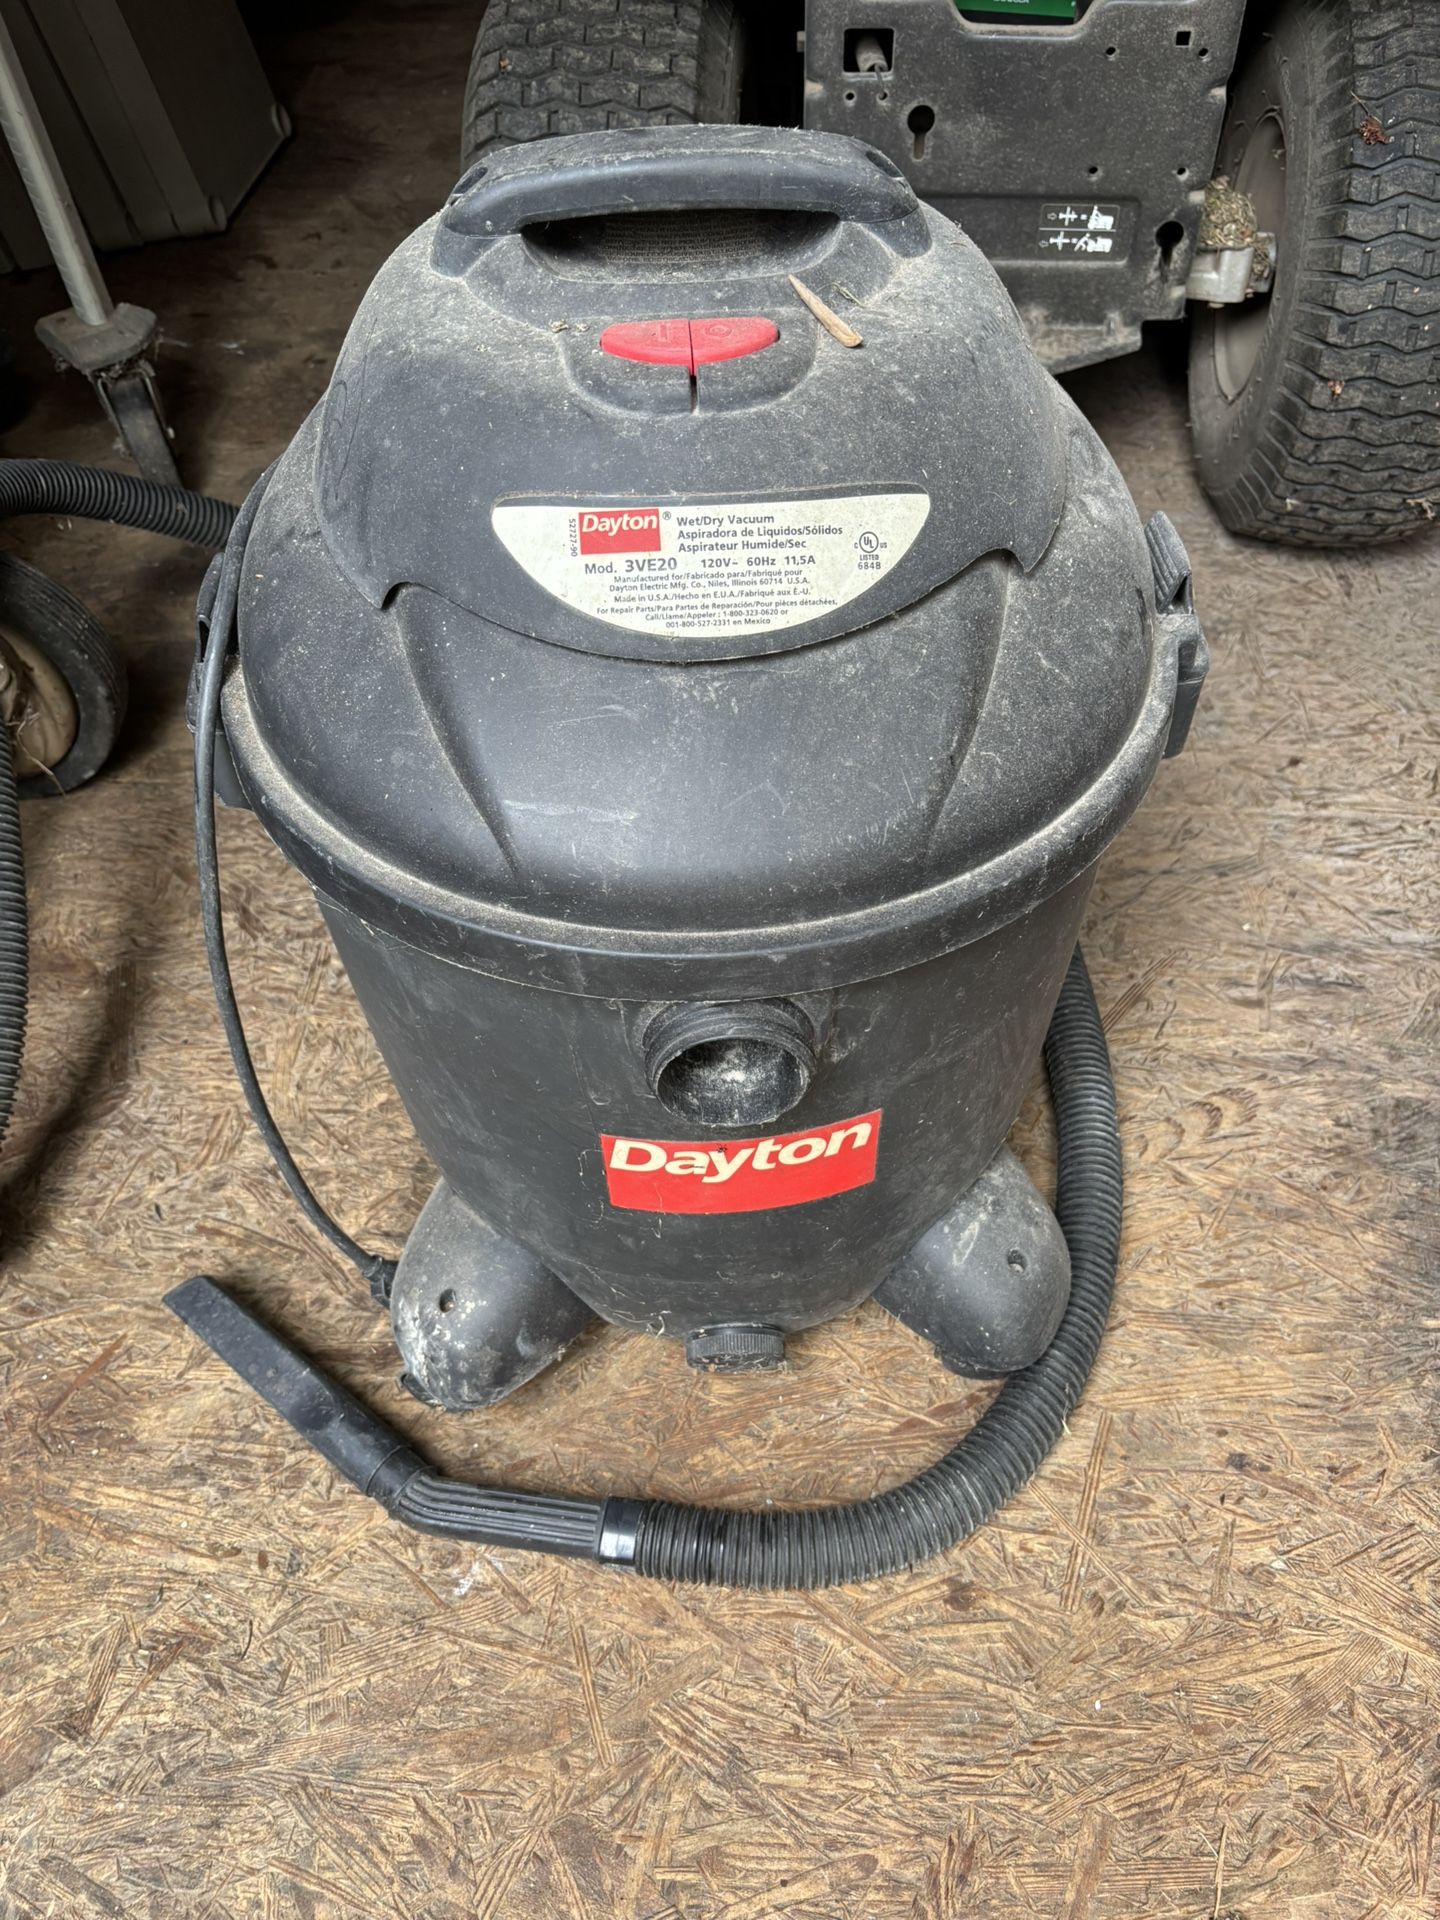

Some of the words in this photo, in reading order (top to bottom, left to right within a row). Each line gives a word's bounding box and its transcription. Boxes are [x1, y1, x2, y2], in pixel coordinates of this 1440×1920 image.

[582, 513, 657, 536] Dayton
[677, 516, 724, 527] Wet/Dry
[728, 515, 774, 525] Vacuum
[569, 518, 577, 557] 52727-90
[678, 528, 737, 541] Aspiradora
[741, 527, 754, 537] de
[678, 541, 739, 554] Aspirateur
[742, 539, 807, 549] Humide/Sec
[585, 562, 617, 574] Mod.
[625, 557, 677, 573] 3VE20
[746, 557, 776, 566] 60Hz
[784, 555, 816, 566] 11,5A
[614, 574, 669, 583] Manufactured
[671, 570, 725, 581] for/Fabricado
[727, 569, 782, 579] para/Fabriqué
[784, 569, 803, 577] pour
[609, 583, 638, 593] Dayton
[640, 582, 668, 591] Electric
[670, 581, 688, 590] Mfg.
[708, 580, 730, 588] Niles,
[731, 578, 757, 587] Illinois
[759, 577, 783, 585] 60714
[614, 595, 636, 603] Made
[638, 594, 646, 602] in
[647, 592, 700, 601] U.S.A./Hecho
[610, 605, 634, 615] Repair
[636, 603, 673, 613] Parts/Para
[675, 602, 698, 611] Partes
[700, 602, 709, 610] de
[711, 600, 773, 610] Reparación/Pour
[775, 598, 798, 608] pièces
[645, 611, 716, 621] Call/Llame/Appeler
[722, 608, 779, 617] 1-800-323-0620
[666, 618, 731, 628] 001-800-527-2331
[744, 617, 771, 625] Mexico
[609, 1122, 872, 1183] Dayton
